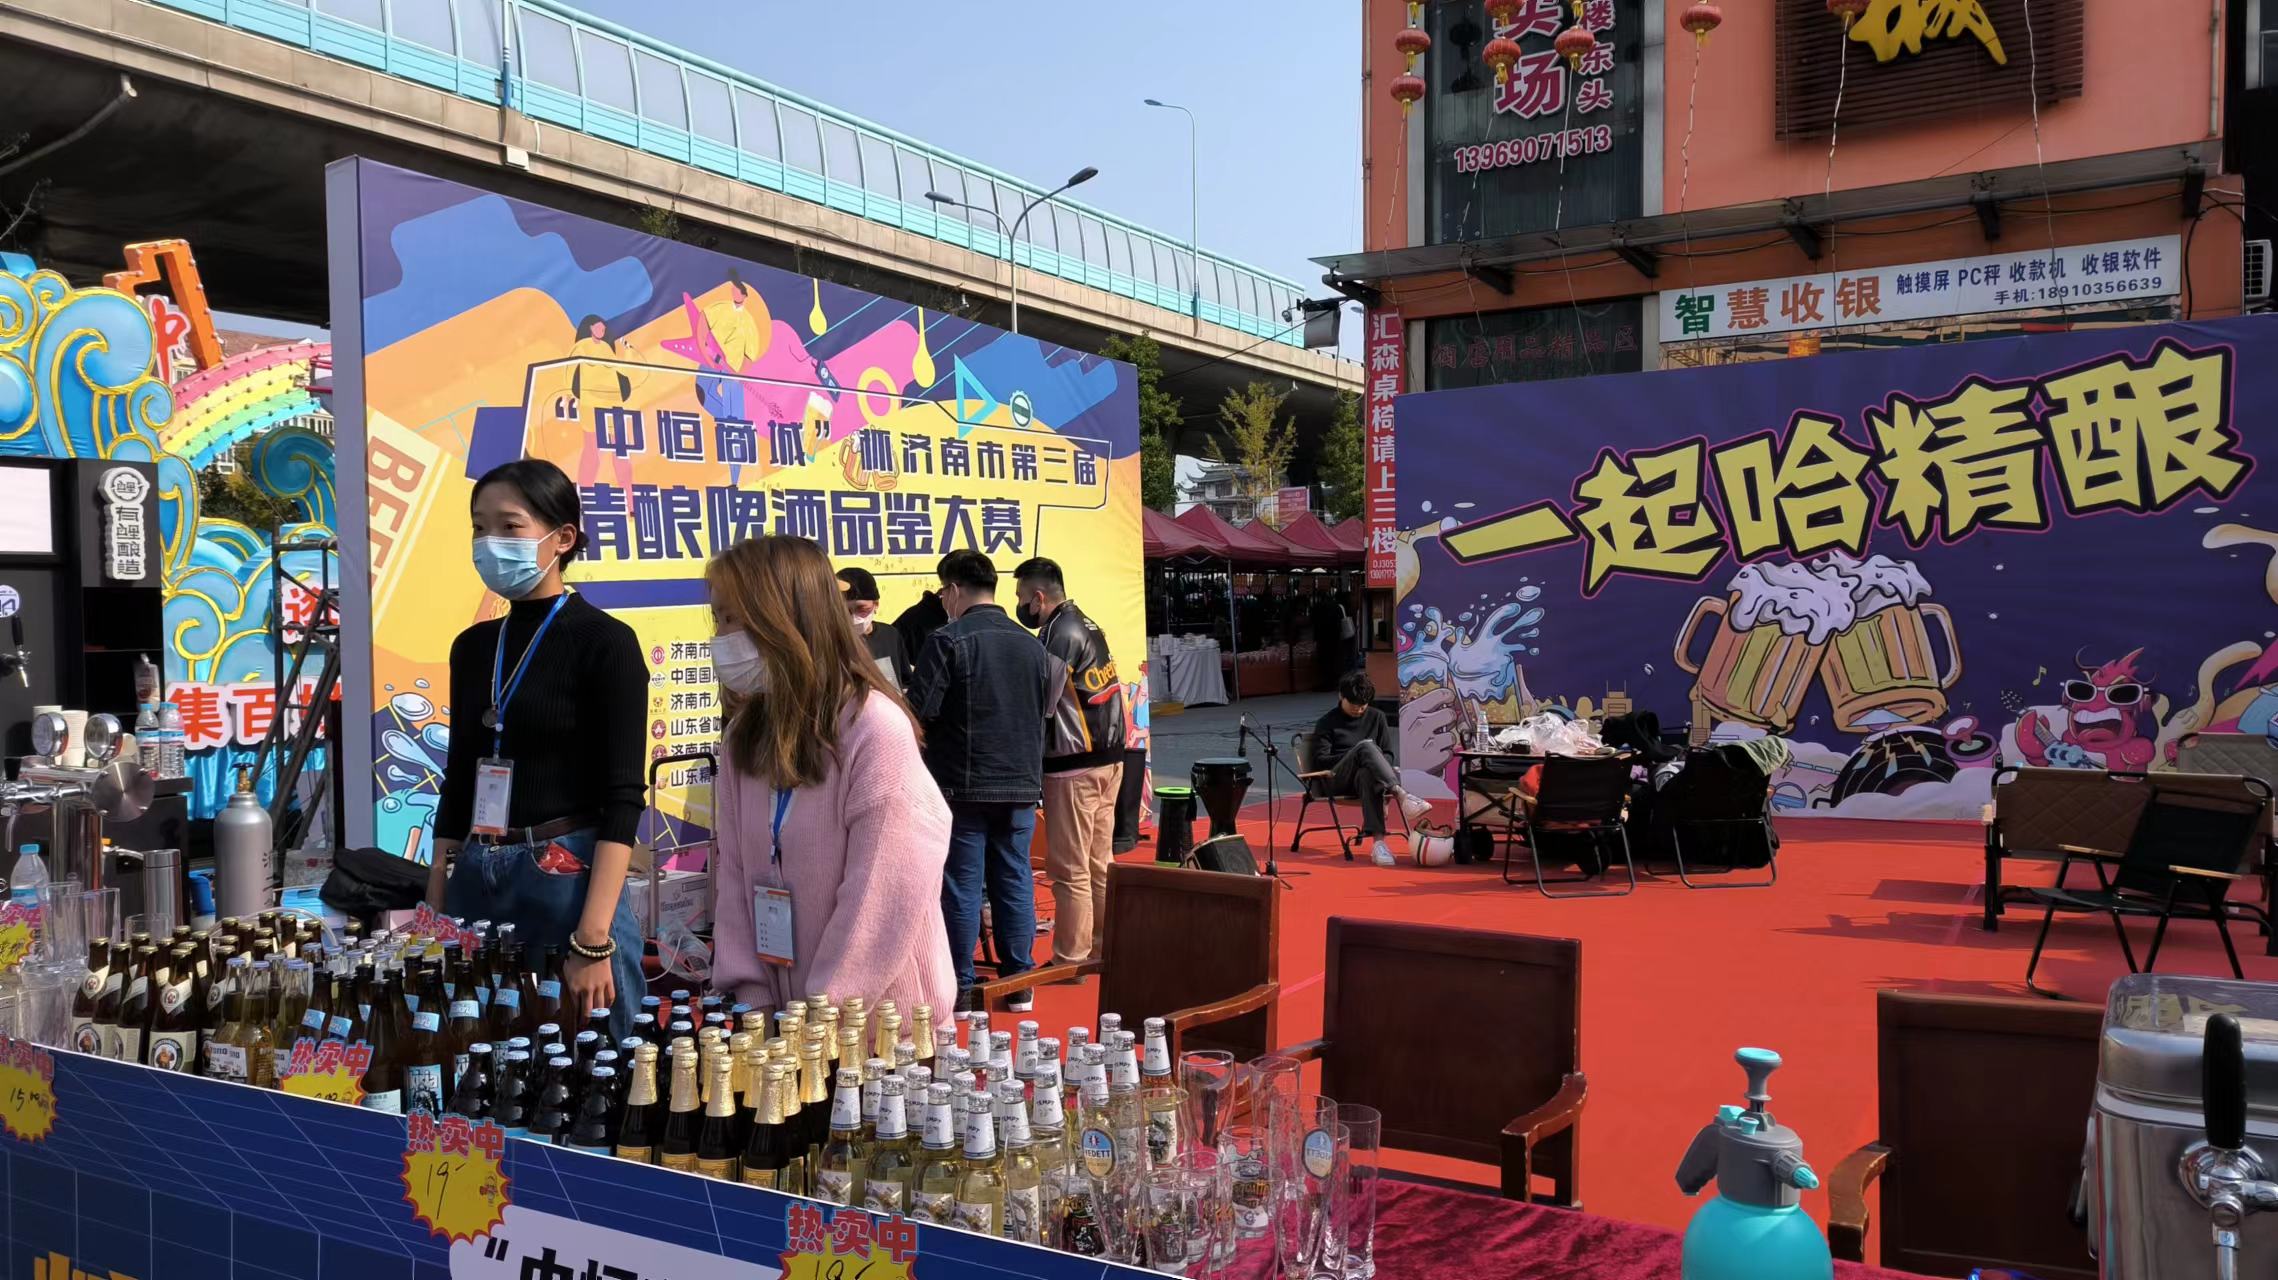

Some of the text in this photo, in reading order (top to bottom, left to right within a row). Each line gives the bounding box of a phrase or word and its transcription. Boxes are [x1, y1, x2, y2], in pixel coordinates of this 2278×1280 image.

[1454, 125, 1612, 172] 13969071513
[1896, 247, 2163, 296] 触摸屏 PC秤 收款机 收银软件
[1675, 276, 1882, 335] 智慧收银
[1371, 312, 1398, 554] 汇森桌椅请上三楼
[1443, 344, 2250, 594] 一起哈精酿
[289, 1039, 372, 1077] 热卖中
[408, 1112, 504, 1161] 热卖中
[788, 1203, 918, 1264] 热卖中
